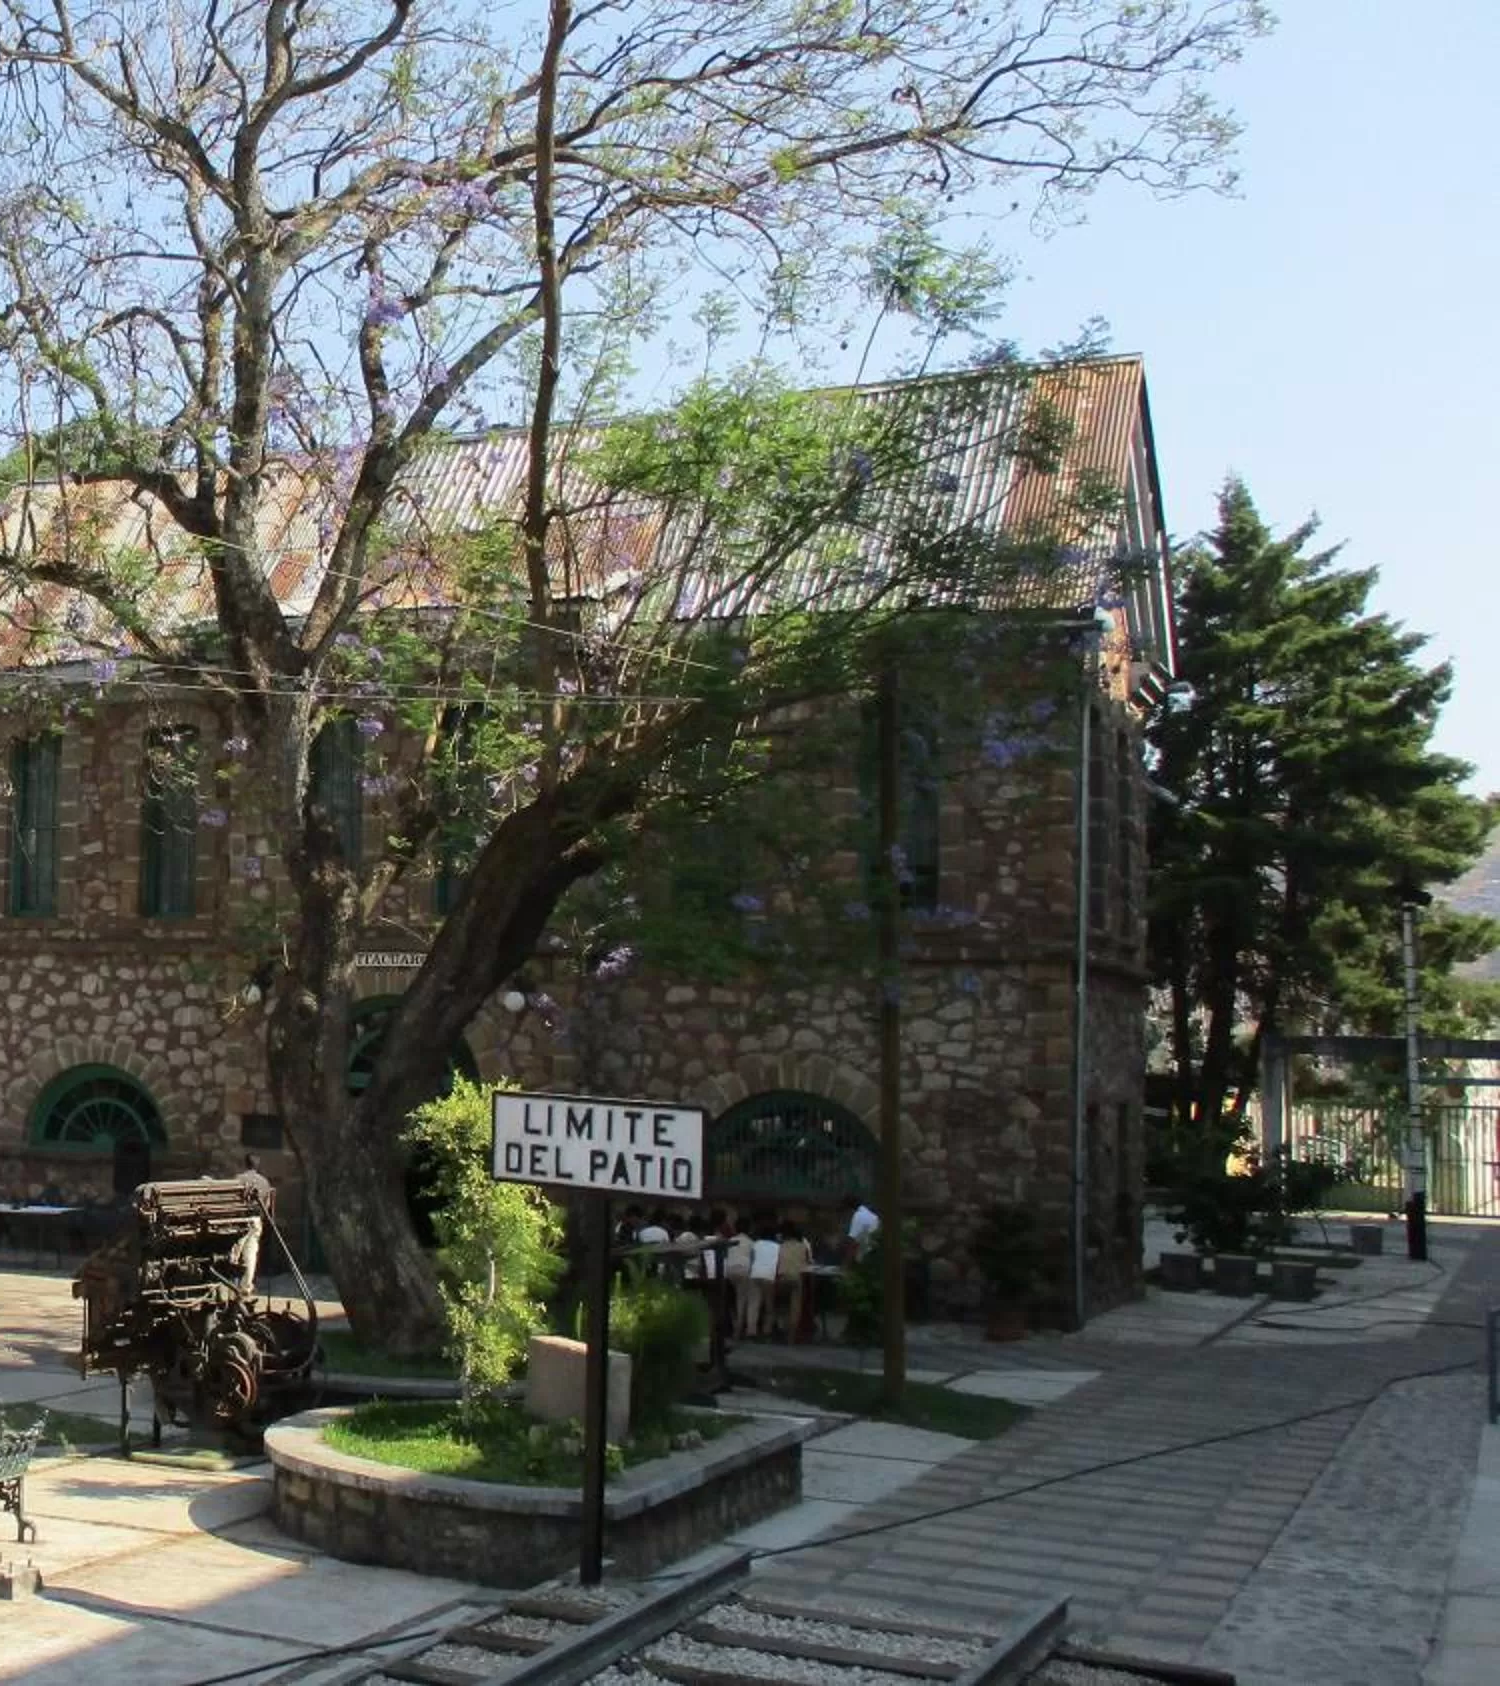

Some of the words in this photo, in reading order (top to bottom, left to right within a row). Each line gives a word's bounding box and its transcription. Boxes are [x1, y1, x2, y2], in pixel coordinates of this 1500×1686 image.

[524, 1103, 676, 1148] LIMITE
[505, 1142, 573, 1179] DEL
[589, 1150, 693, 1191] PATIO
